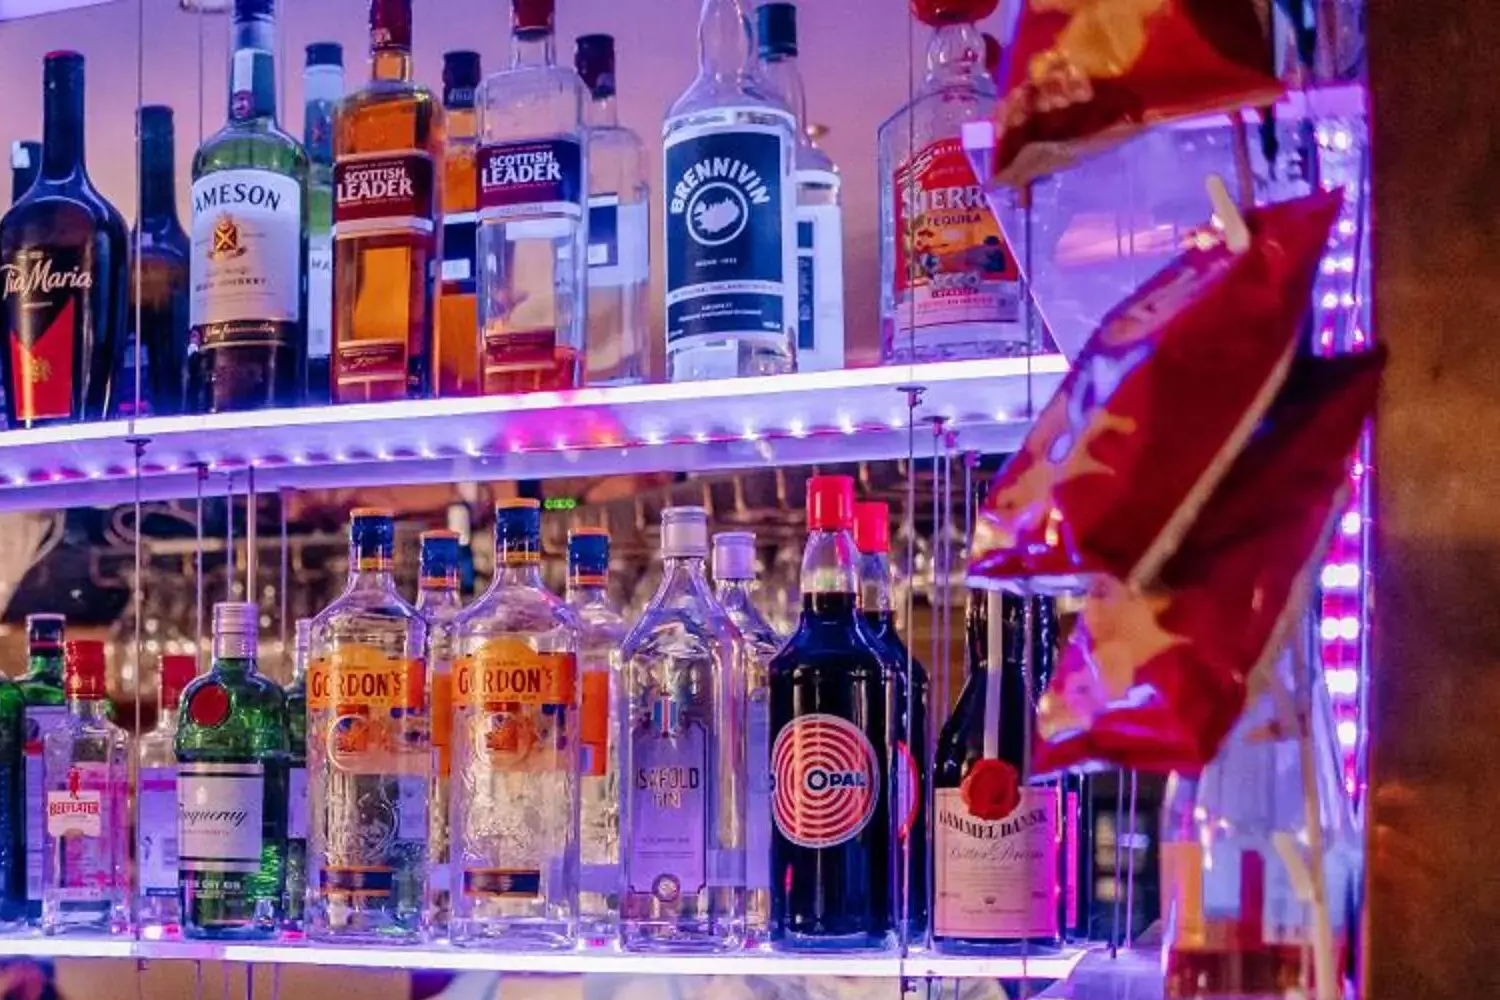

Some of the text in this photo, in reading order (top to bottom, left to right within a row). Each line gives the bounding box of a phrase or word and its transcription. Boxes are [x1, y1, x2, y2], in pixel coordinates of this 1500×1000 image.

[490, 150, 554, 169] SCOTTISH
[343, 166, 406, 183] SCOTTISH
[482, 161, 562, 187] LEADER
[195, 183, 281, 213] AMESON
[336, 177, 414, 202] LEADER
[902, 180, 988, 219] SIERR
[927, 213, 981, 227] TEQUILA
[24, 259, 93, 297] Maria
[807, 768, 866, 791] OPAL
[49, 801, 101, 816] BEEFEATER
[939, 809, 1049, 840] GAMMEL DANSK
